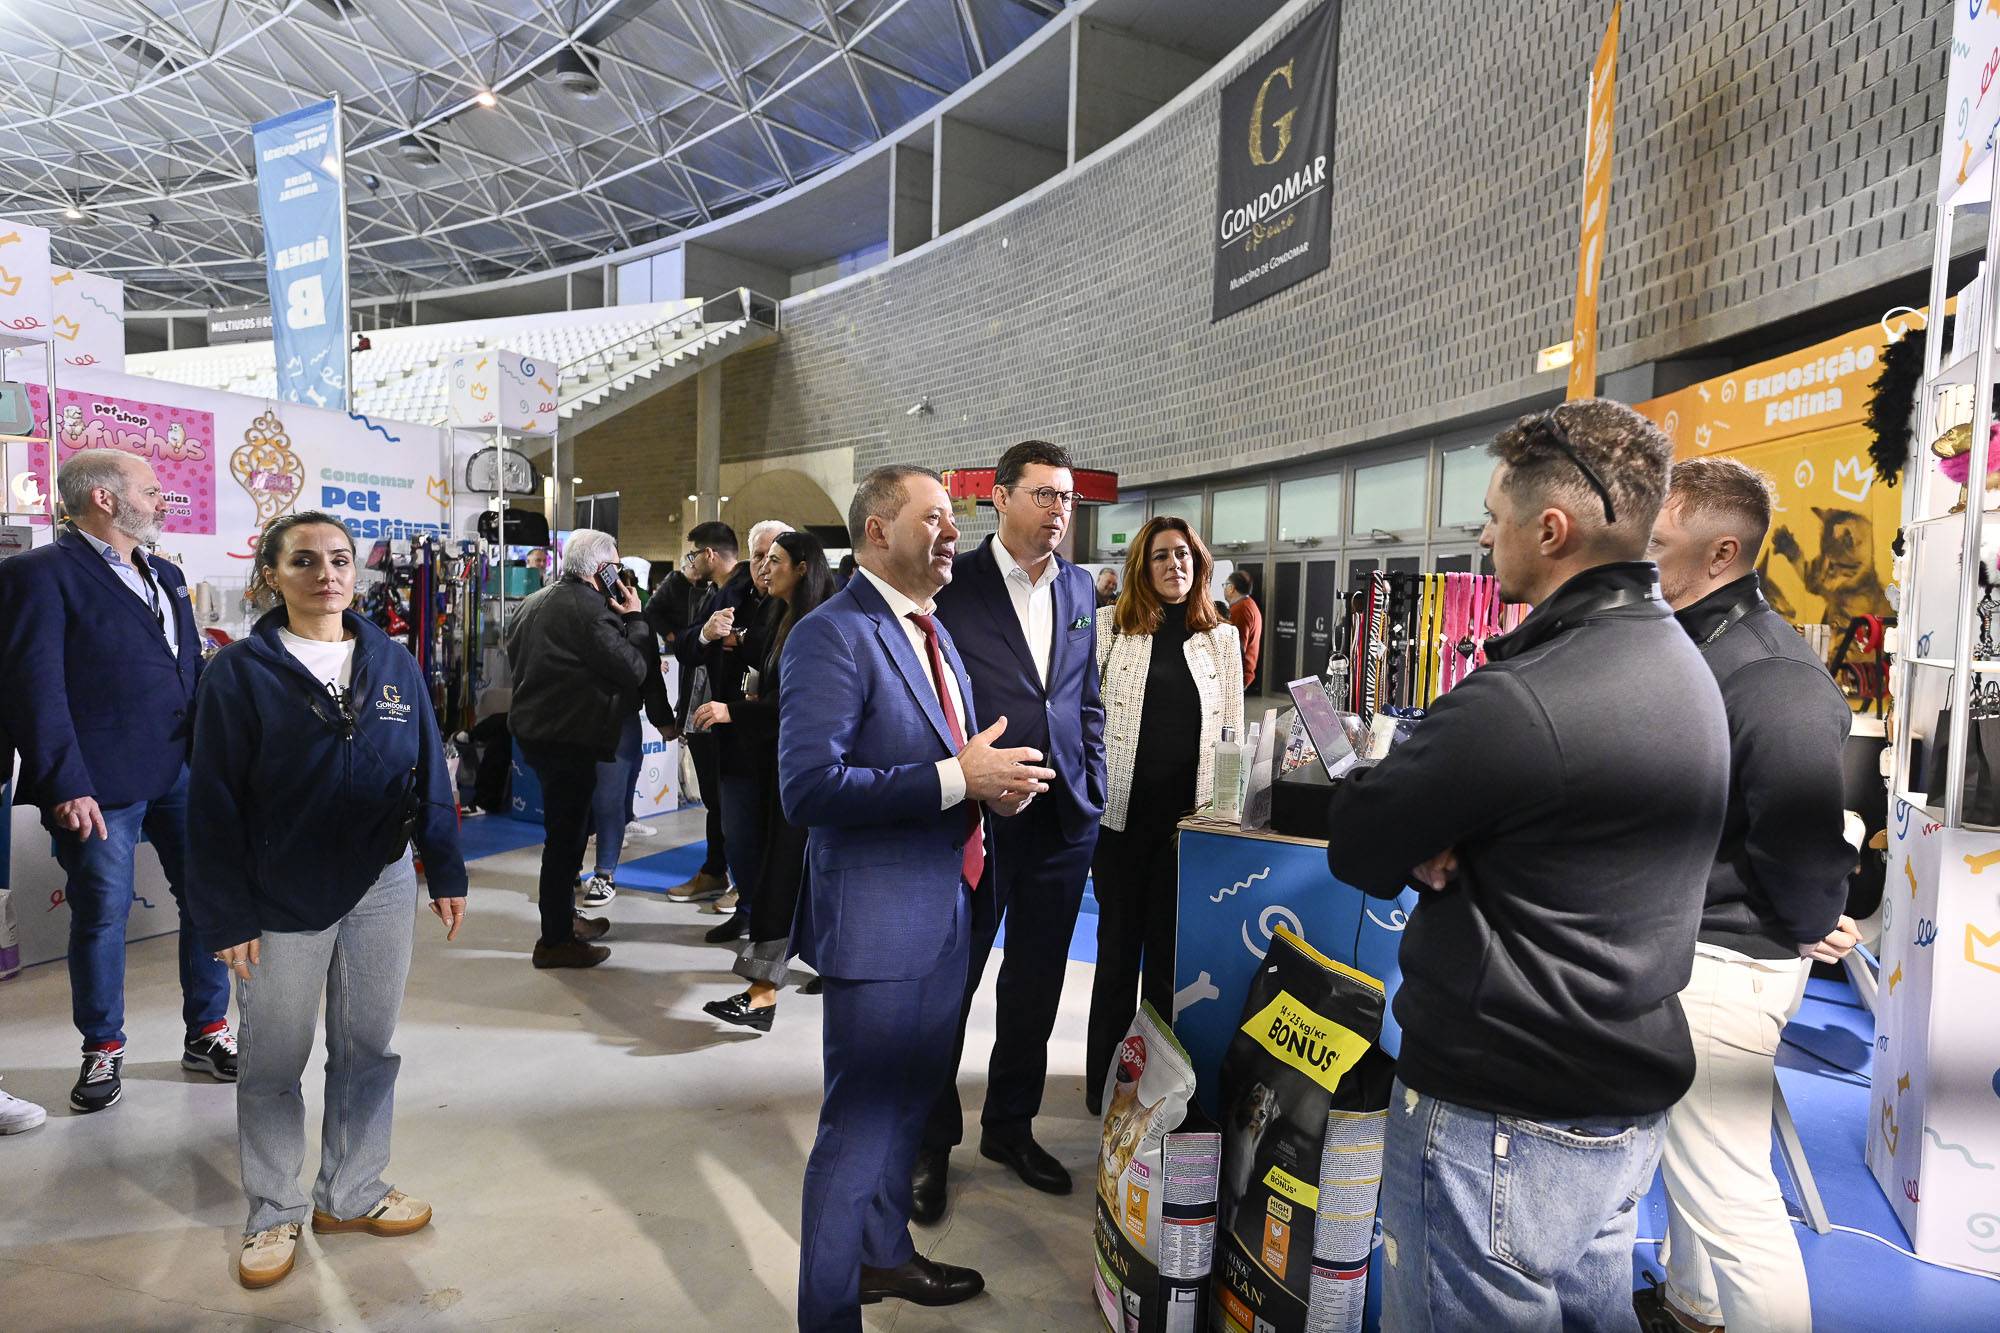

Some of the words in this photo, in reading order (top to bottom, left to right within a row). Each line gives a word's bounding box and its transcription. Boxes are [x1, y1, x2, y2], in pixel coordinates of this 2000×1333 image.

[1248, 57, 1298, 166] G
[1221, 155, 1327, 240] GONDOMAR
[1269, 241, 1309, 270] GONDOMAR
[1744, 345, 1875, 403] Exposição
[94, 403, 118, 416] pet
[116, 411, 148, 426] shop
[1765, 387, 1842, 427] Felina
[320, 467, 415, 489] Gondomar
[321, 486, 380, 512] Pet
[383, 684, 401, 703] G
[1270, 1199, 1289, 1215] HIGH
